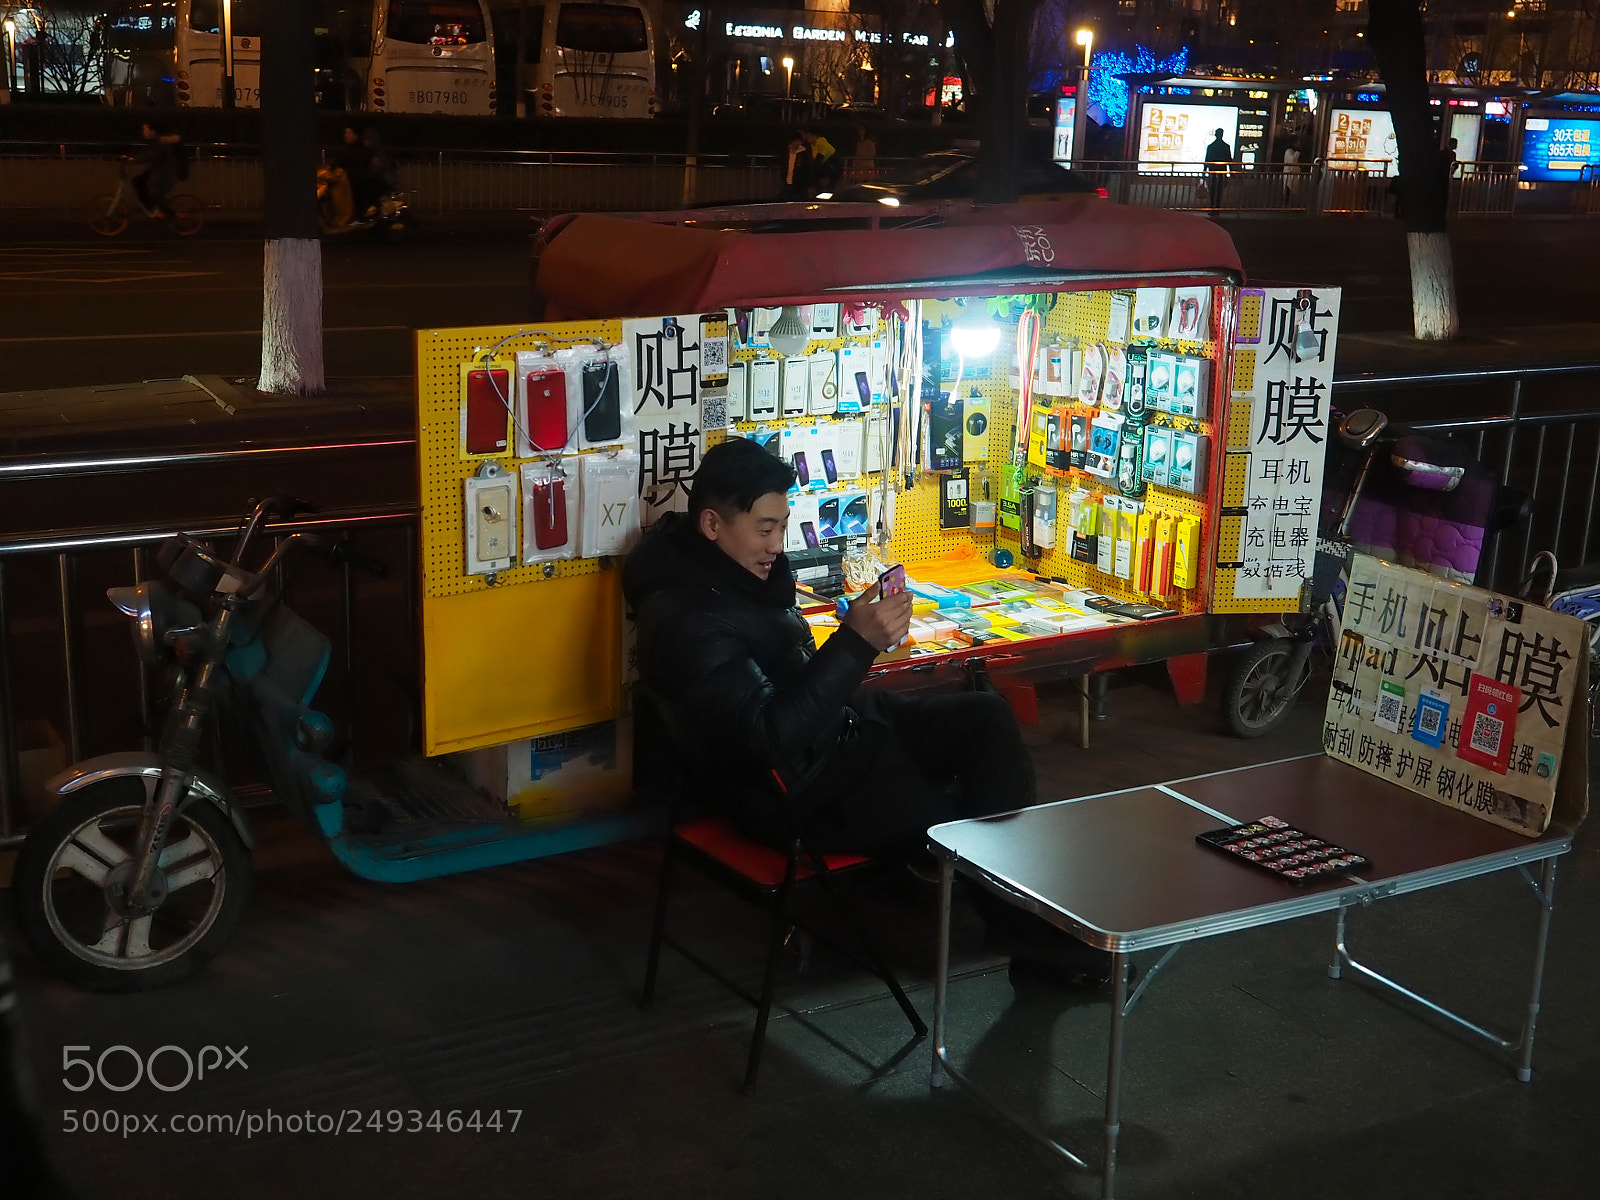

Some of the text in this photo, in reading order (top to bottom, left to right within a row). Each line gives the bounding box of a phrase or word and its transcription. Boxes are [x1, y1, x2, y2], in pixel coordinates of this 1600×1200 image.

[793, 26, 845, 41] GARDEN
[1259, 458, 1311, 485] 耳机
[601, 503, 627, 526] X7
[1249, 495, 1313, 516] 充电宝
[1247, 526, 1309, 547] 充电器
[1349, 582, 1408, 638] 手机
[1324, 720, 1355, 759] 耐刮
[1395, 748, 1433, 789] 护屏
[1436, 765, 1496, 815] 钢化膜
